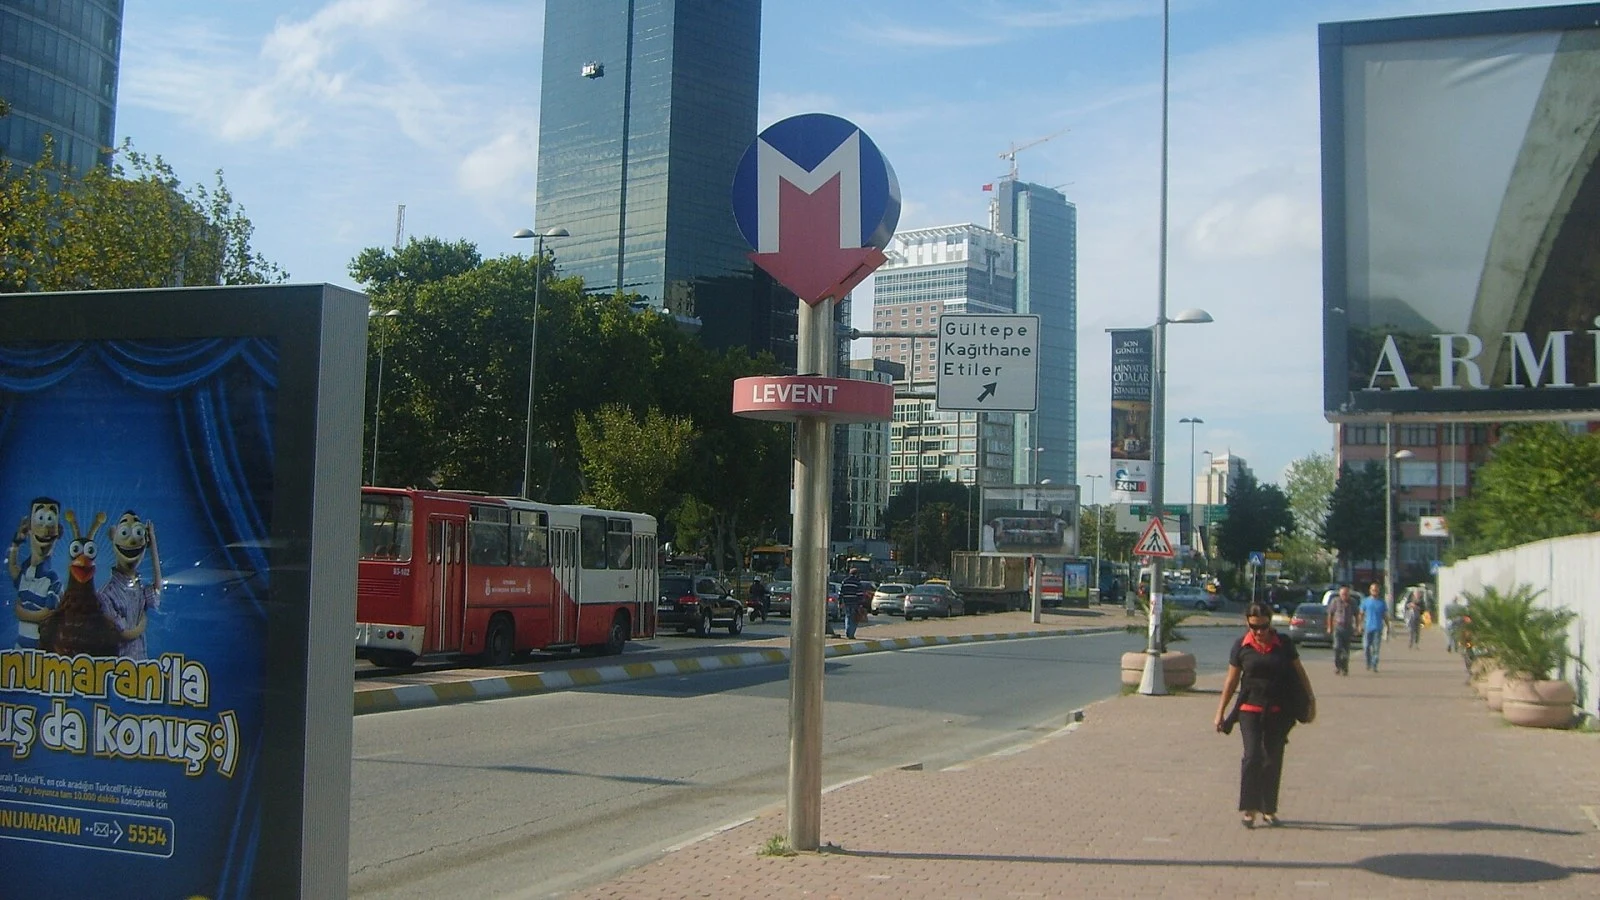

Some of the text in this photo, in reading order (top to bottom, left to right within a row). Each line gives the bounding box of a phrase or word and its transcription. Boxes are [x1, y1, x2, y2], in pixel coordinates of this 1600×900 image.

[945, 322, 1027, 340] Gültepe
[944, 342, 1031, 359] Kağıthane
[1123, 340, 1139, 348] SON
[944, 362, 1002, 376] Etiler
[1113, 372, 1150, 383] ODALAR
[752, 384, 838, 404] LEVENT
[1117, 481, 1138, 491] ZEN
[1, 651, 207, 705] numaran'la
[41, 701, 86, 751] da
[133, 785, 168, 798] öğrenmek
[120, 795, 155, 808] konuşmak
[155, 799, 168, 810] için
[1, 809, 168, 846] NUMARAM 5554
